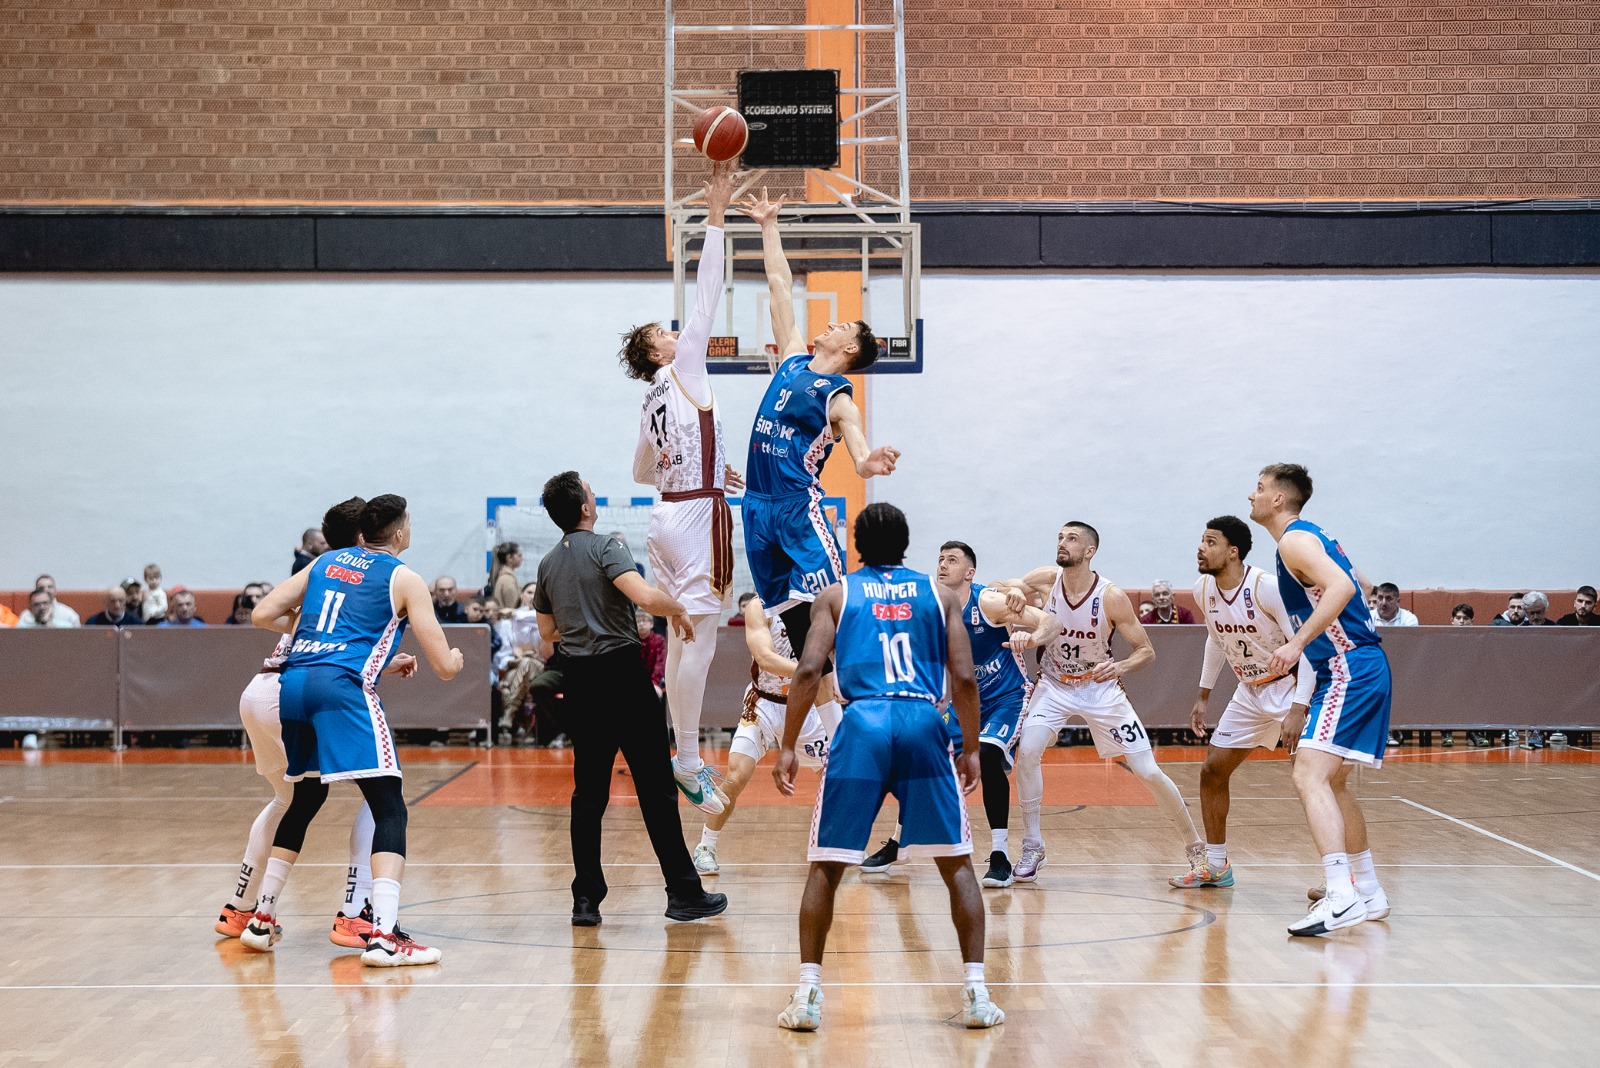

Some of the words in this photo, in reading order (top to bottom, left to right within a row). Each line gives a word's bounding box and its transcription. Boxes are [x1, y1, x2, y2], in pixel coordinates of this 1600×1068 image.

[744, 105, 798, 115] SCOREBOARD
[799, 104, 833, 115] SYSTEMS
[708, 337, 736, 346] CLEAN
[892, 339, 907, 347] FIBA
[708, 346, 736, 356] GAME
[650, 404, 668, 448] 17
[325, 564, 365, 585] FAKS
[862, 582, 917, 600] HUNTER
[315, 589, 346, 634] 11
[872, 602, 912, 621] FAKS
[1060, 628, 1096, 640] osna
[1215, 621, 1257, 633] bosna
[878, 632, 916, 683] 10
[1060, 643, 1080, 660] 31
[1238, 640, 1252, 658] 2
[1120, 720, 1145, 743] 31
[234, 862, 254, 899] ELITE
[345, 866, 358, 904] ELITE
